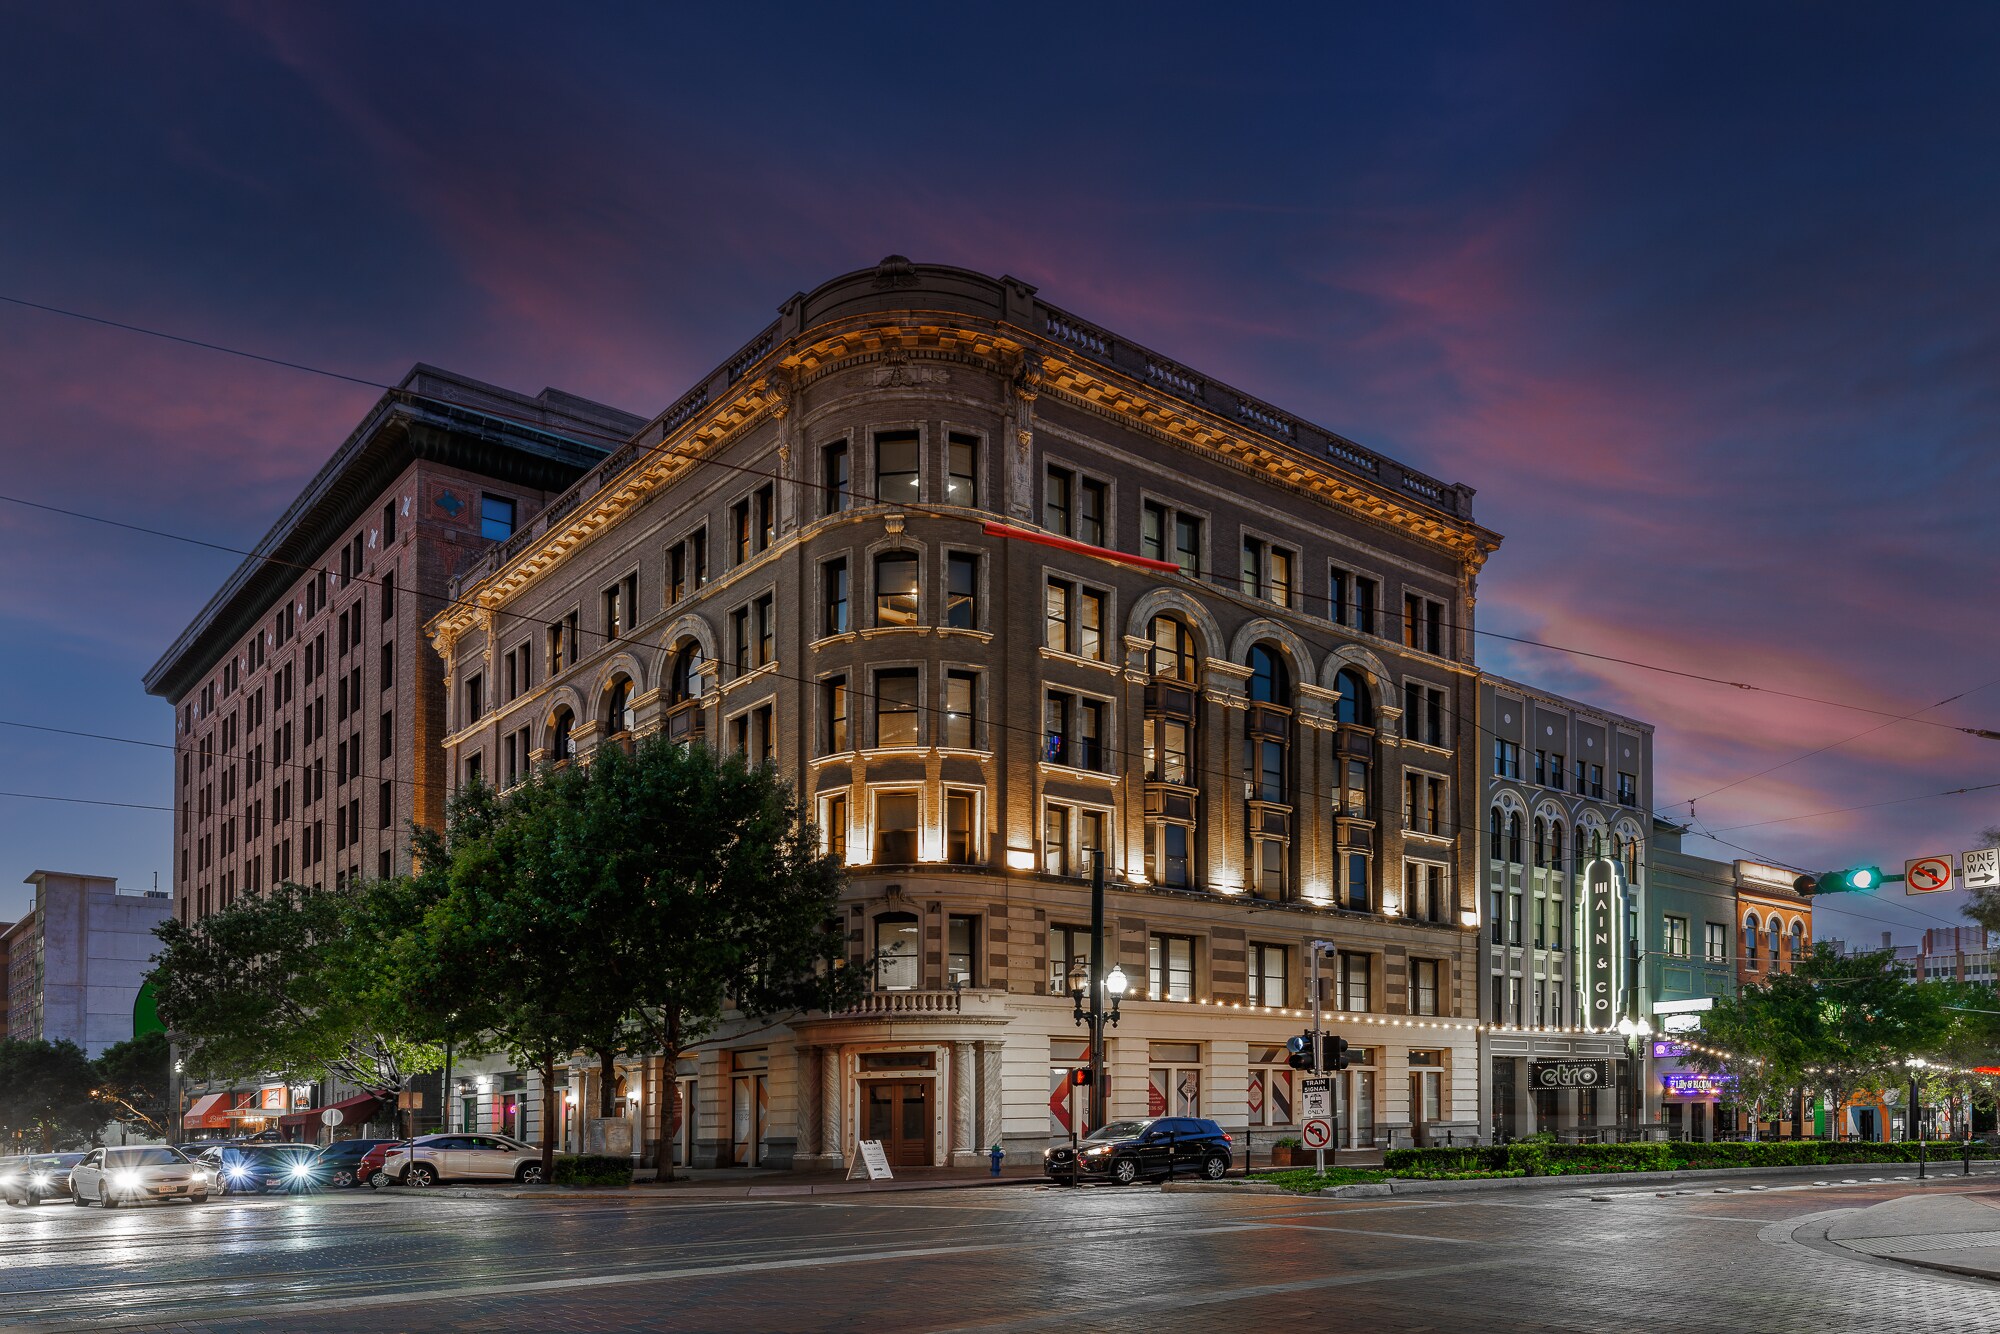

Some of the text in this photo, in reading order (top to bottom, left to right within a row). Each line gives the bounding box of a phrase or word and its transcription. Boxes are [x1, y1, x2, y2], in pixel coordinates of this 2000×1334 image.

[1967, 851, 1994, 863] ONE
[1967, 862, 1995, 873] WAY
[1596, 957, 1608, 969] &
[1595, 981, 1608, 1010] CO
[1540, 1064, 1598, 1086] etro
